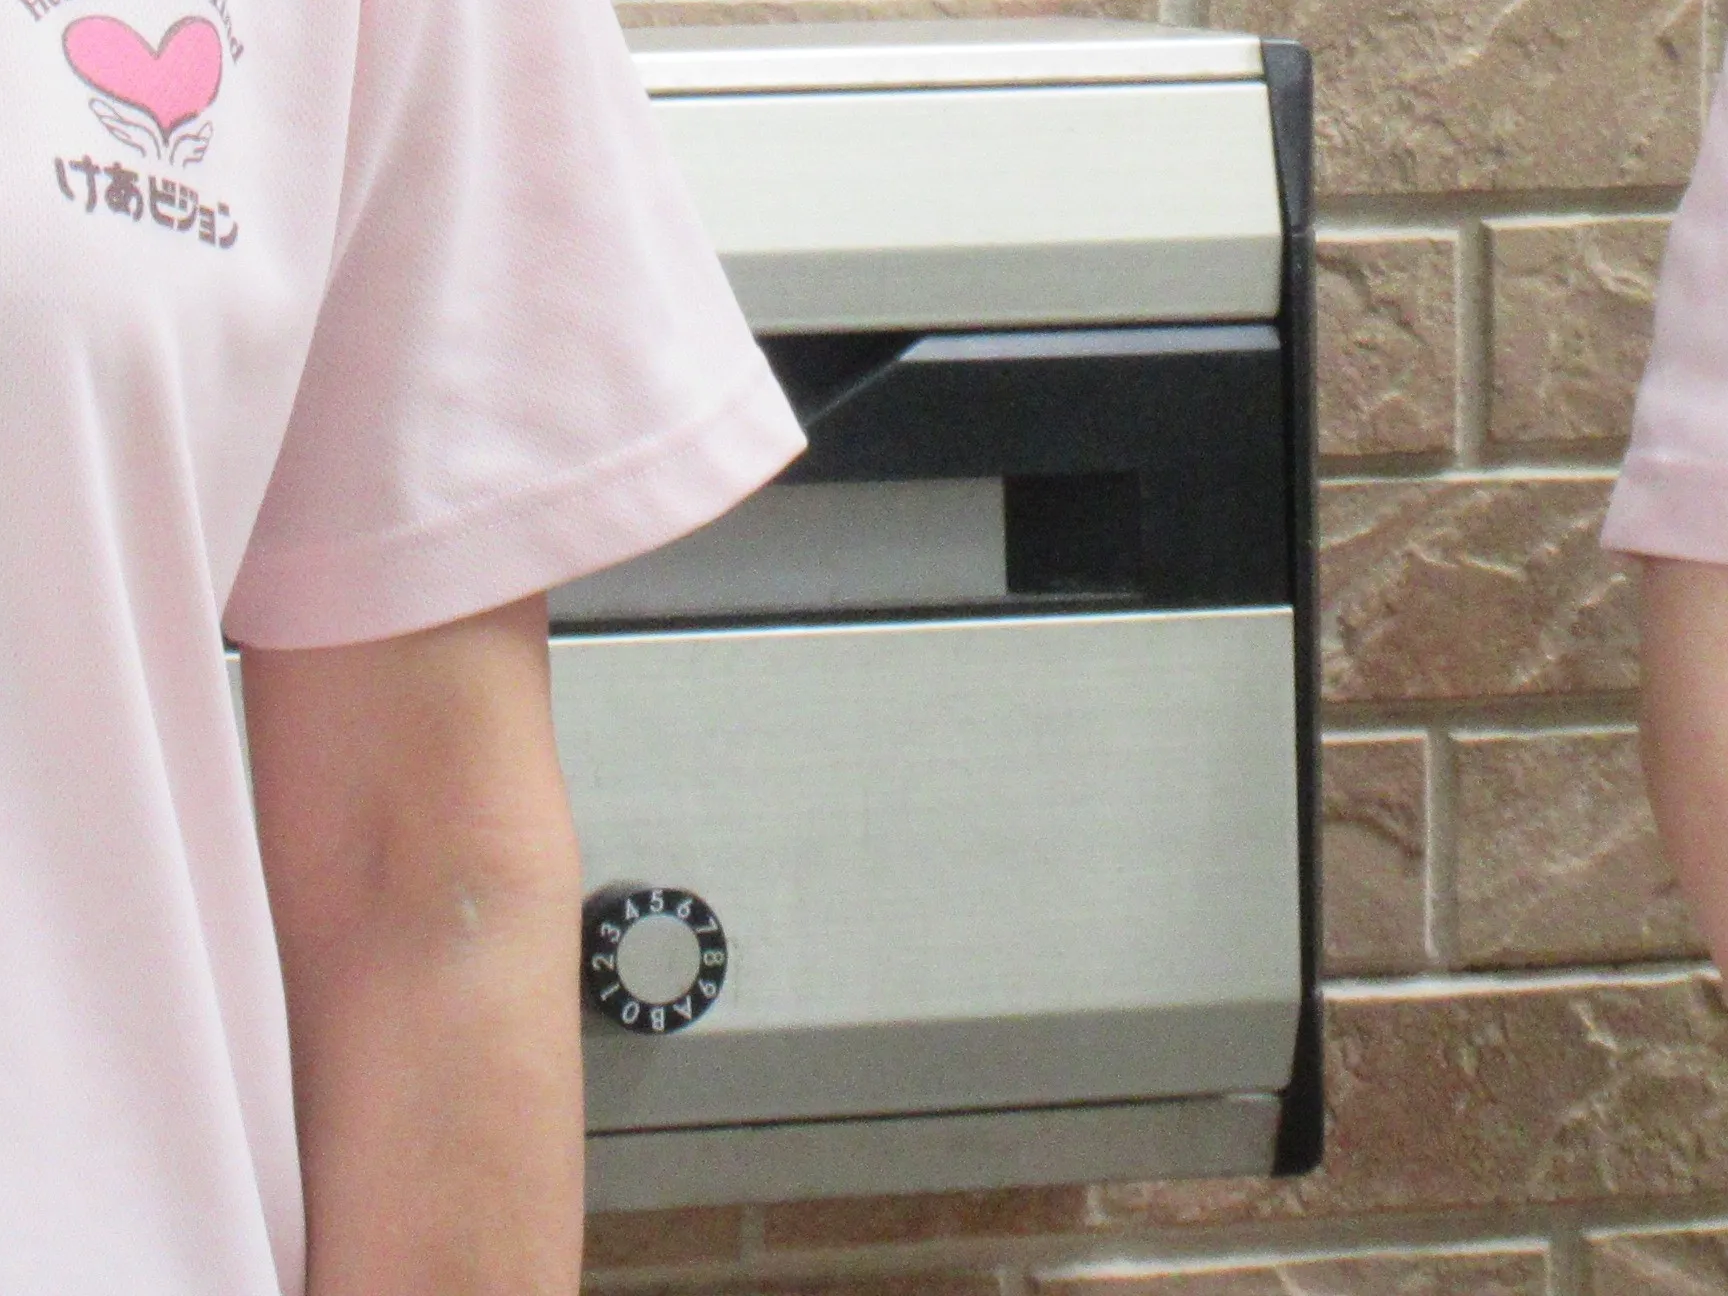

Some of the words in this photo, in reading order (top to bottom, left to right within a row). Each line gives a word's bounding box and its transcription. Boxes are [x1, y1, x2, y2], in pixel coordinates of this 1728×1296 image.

[54, 154, 239, 249] けあビジョン
